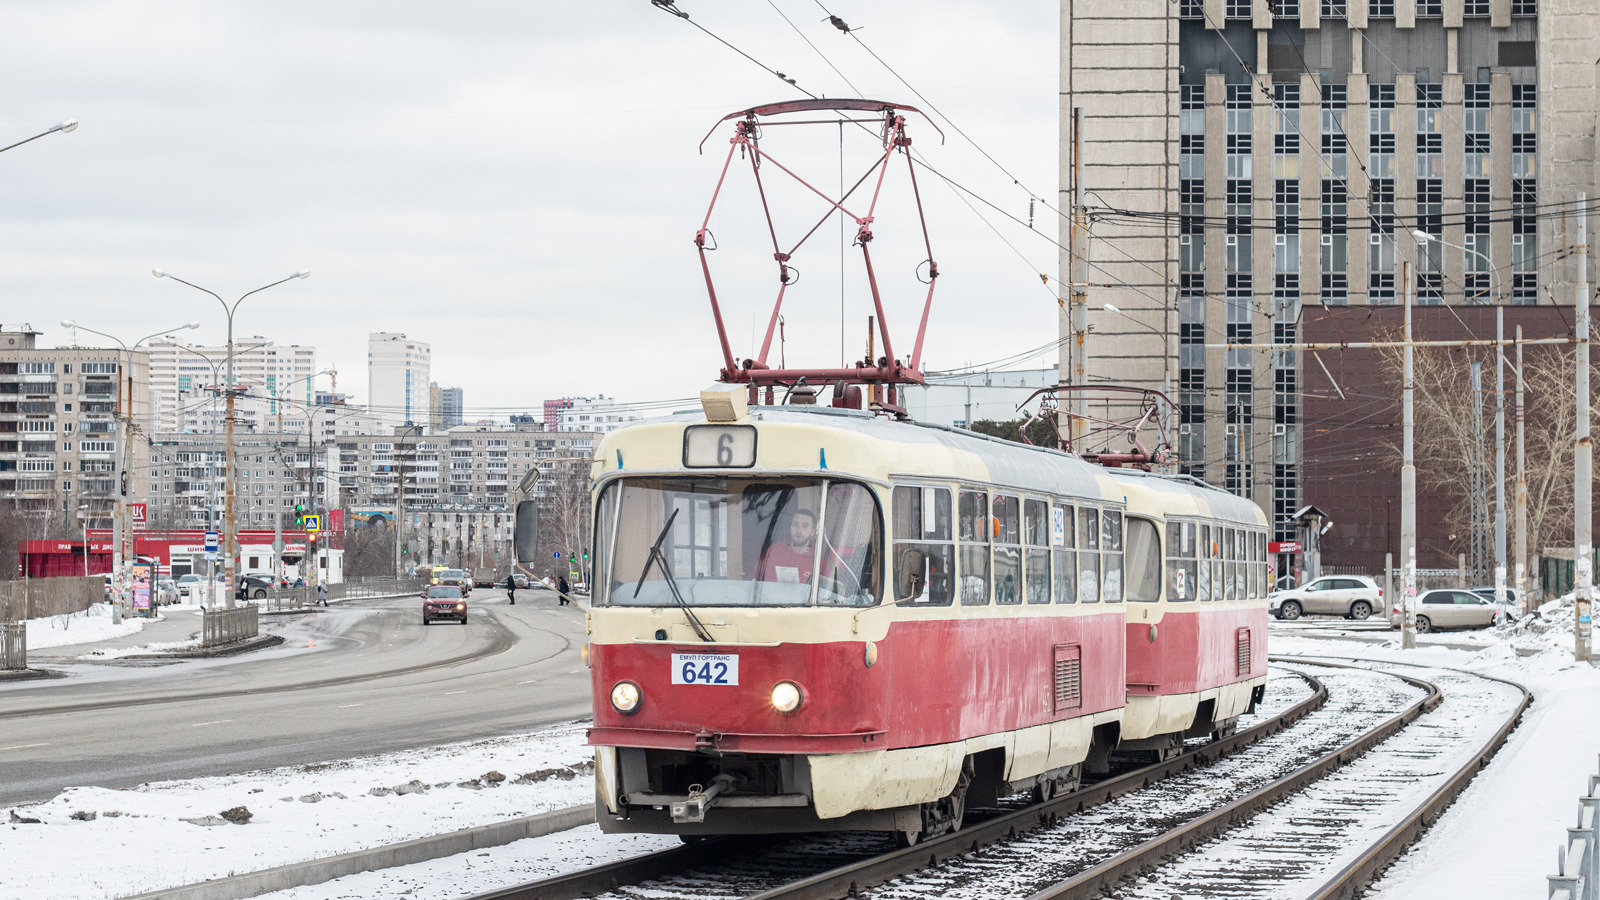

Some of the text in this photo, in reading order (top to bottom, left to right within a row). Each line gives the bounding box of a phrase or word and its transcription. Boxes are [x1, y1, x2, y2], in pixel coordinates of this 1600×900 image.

[717, 433, 733, 466] 6
[1177, 572, 1184, 589] 2
[682, 661, 728, 684] 642
